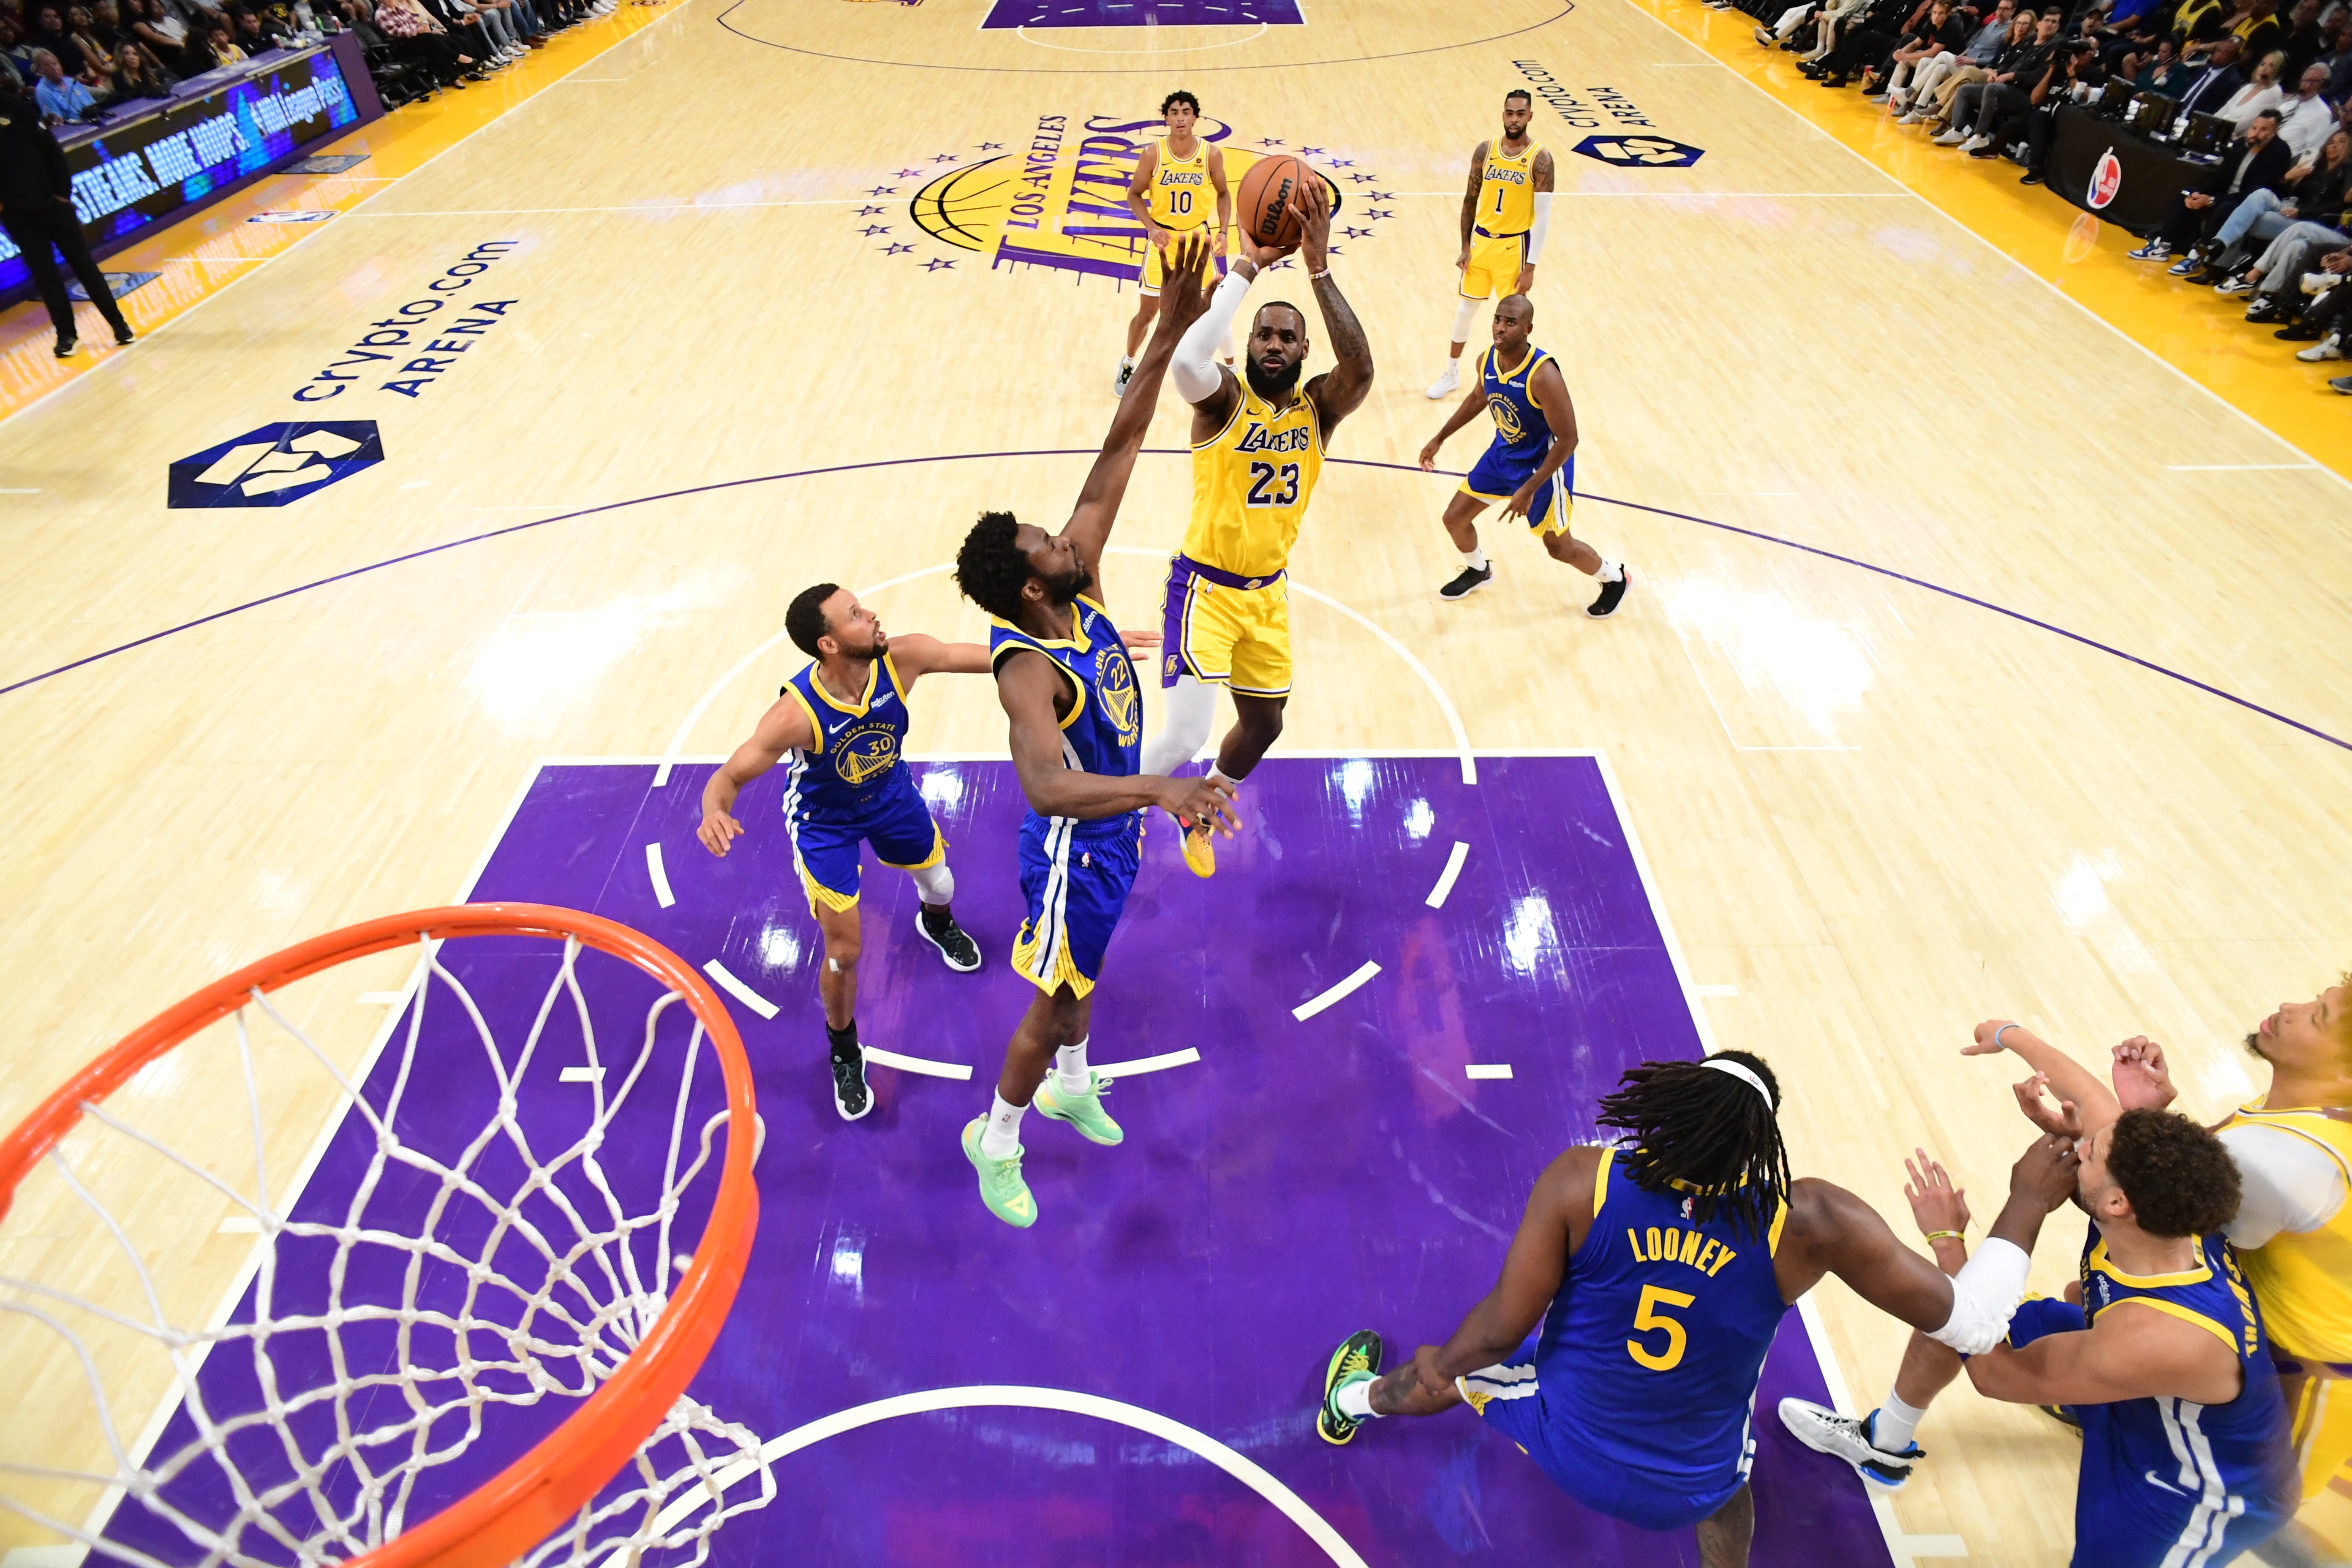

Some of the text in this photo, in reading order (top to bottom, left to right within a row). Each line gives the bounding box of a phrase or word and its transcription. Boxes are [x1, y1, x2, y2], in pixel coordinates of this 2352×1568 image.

[1512, 60, 1600, 128] crypto.com
[1586, 87, 1657, 128] ARENA
[143, 131, 203, 188] MORE
[188, 111, 251, 168] HOOPS.
[1006, 114, 1067, 230] LOS ANGELES
[1159, 169, 1203, 186] LAKERS
[1484, 164, 1526, 185] LAKERS
[1170, 191, 1193, 215] 10
[1261, 178, 1293, 235] Wilson
[1494, 188, 1505, 215] 1
[293, 241, 520, 402] crypto.com
[377, 299, 520, 398] ARENA
[1289, 404, 1308, 414] bibigo
[1506, 410, 1514, 423] 3
[1233, 422, 1309, 454] LAKERS
[1245, 461, 1300, 508] 23
[1082, 610, 1098, 632] kuten
[1095, 649, 1106, 686] OLDEN
[1111, 660, 1126, 691] 22
[871, 691, 895, 709] Rakuten
[830, 722, 896, 754] GOLDEN STATE
[868, 737, 891, 757] 30
[1627, 1227, 1737, 1277] LOONEY
[1627, 1284, 1696, 1371] 5
